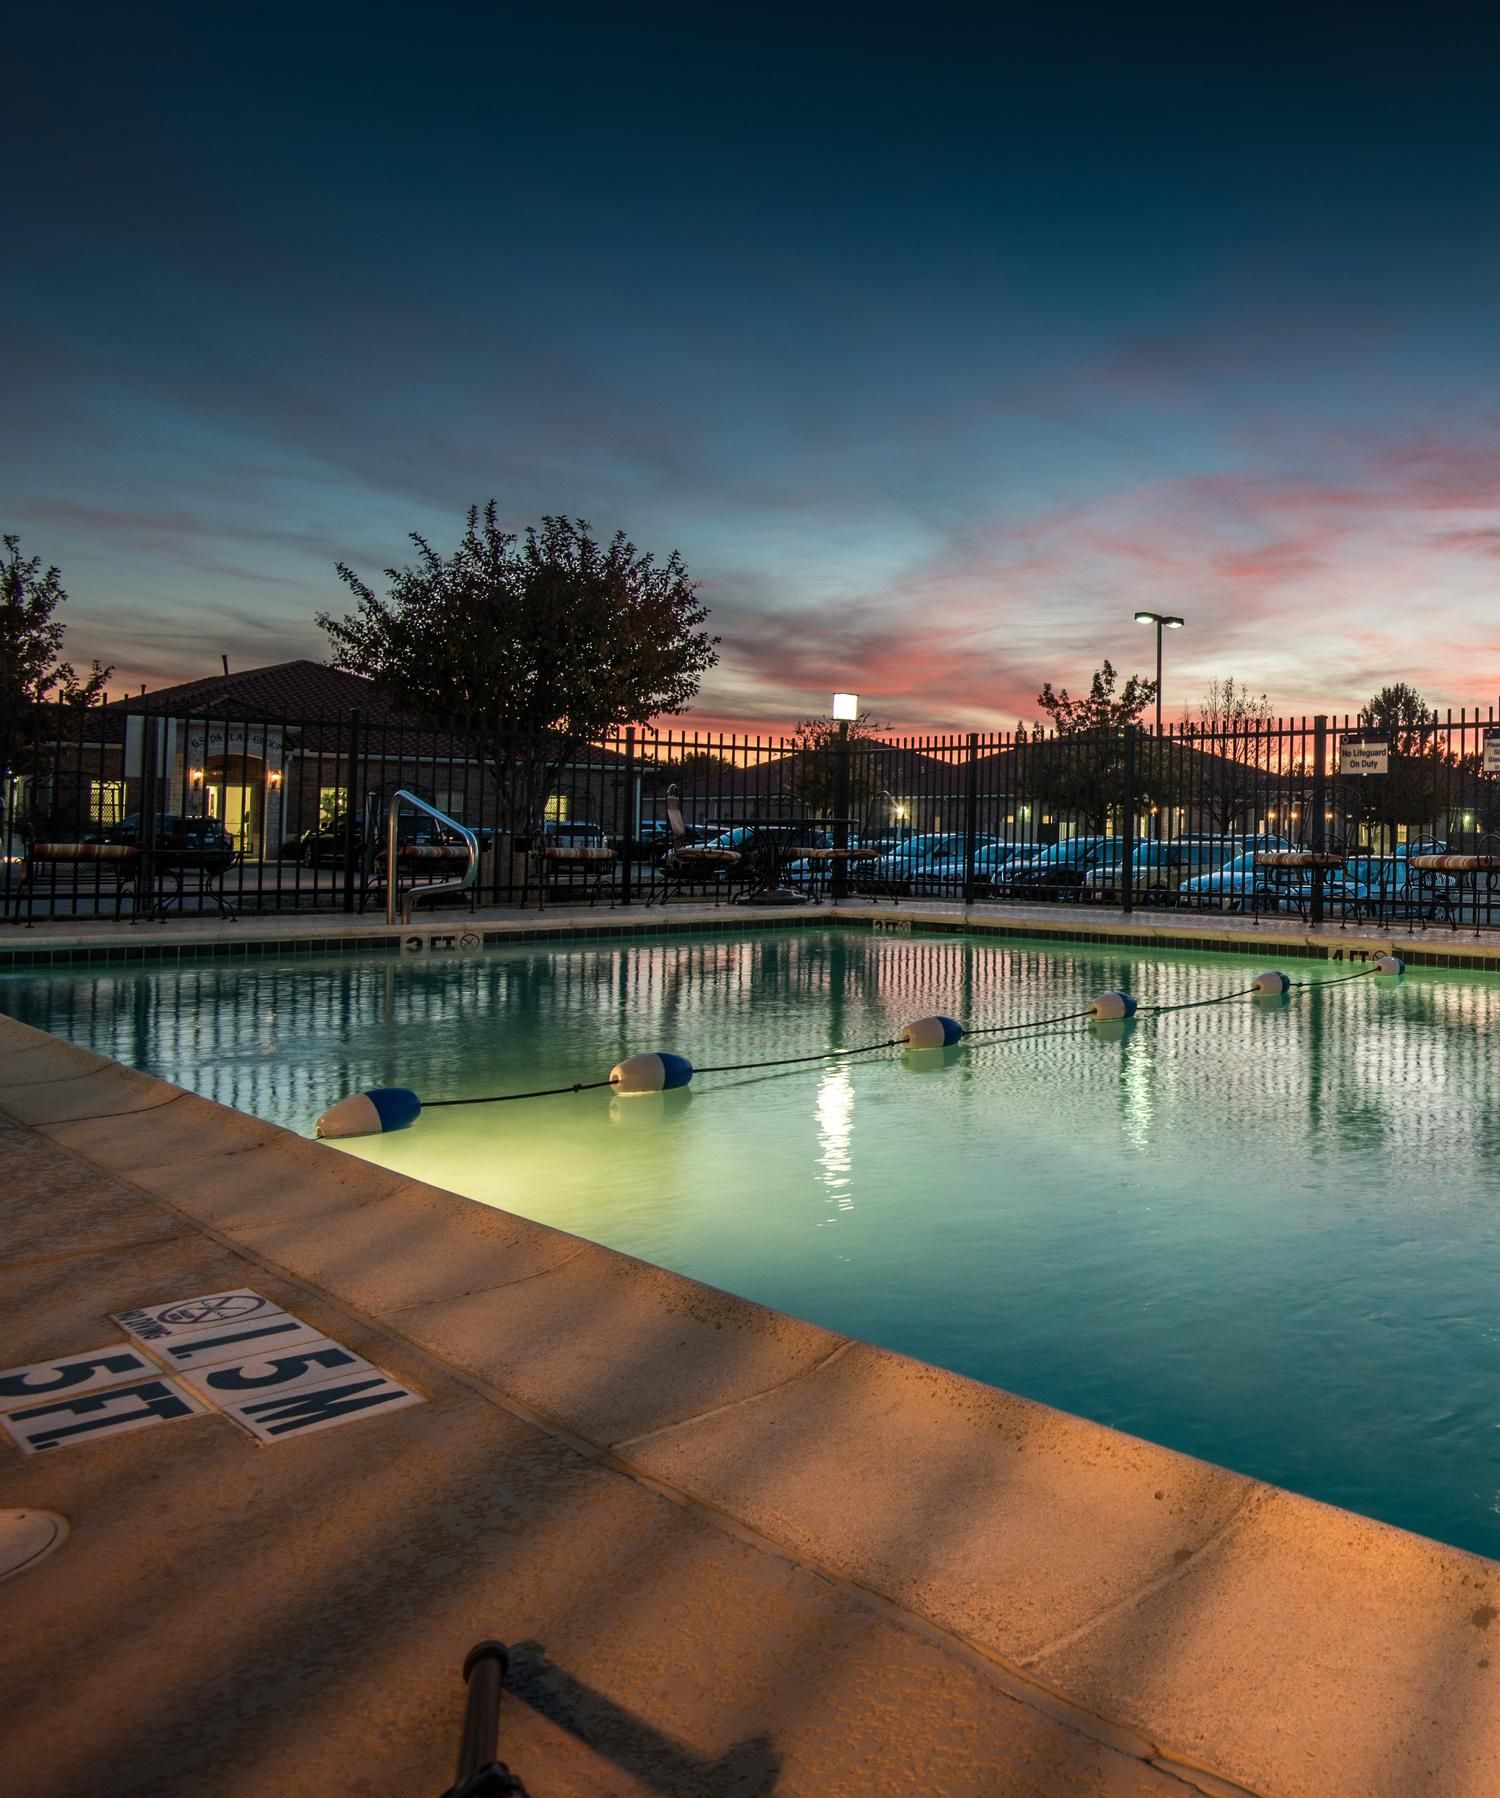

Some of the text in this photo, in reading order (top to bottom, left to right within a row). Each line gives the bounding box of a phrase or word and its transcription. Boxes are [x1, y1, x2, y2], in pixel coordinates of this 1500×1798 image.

[1342, 748, 1387, 758] No Lifeguard
[1350, 760, 1378, 769] On Duty
